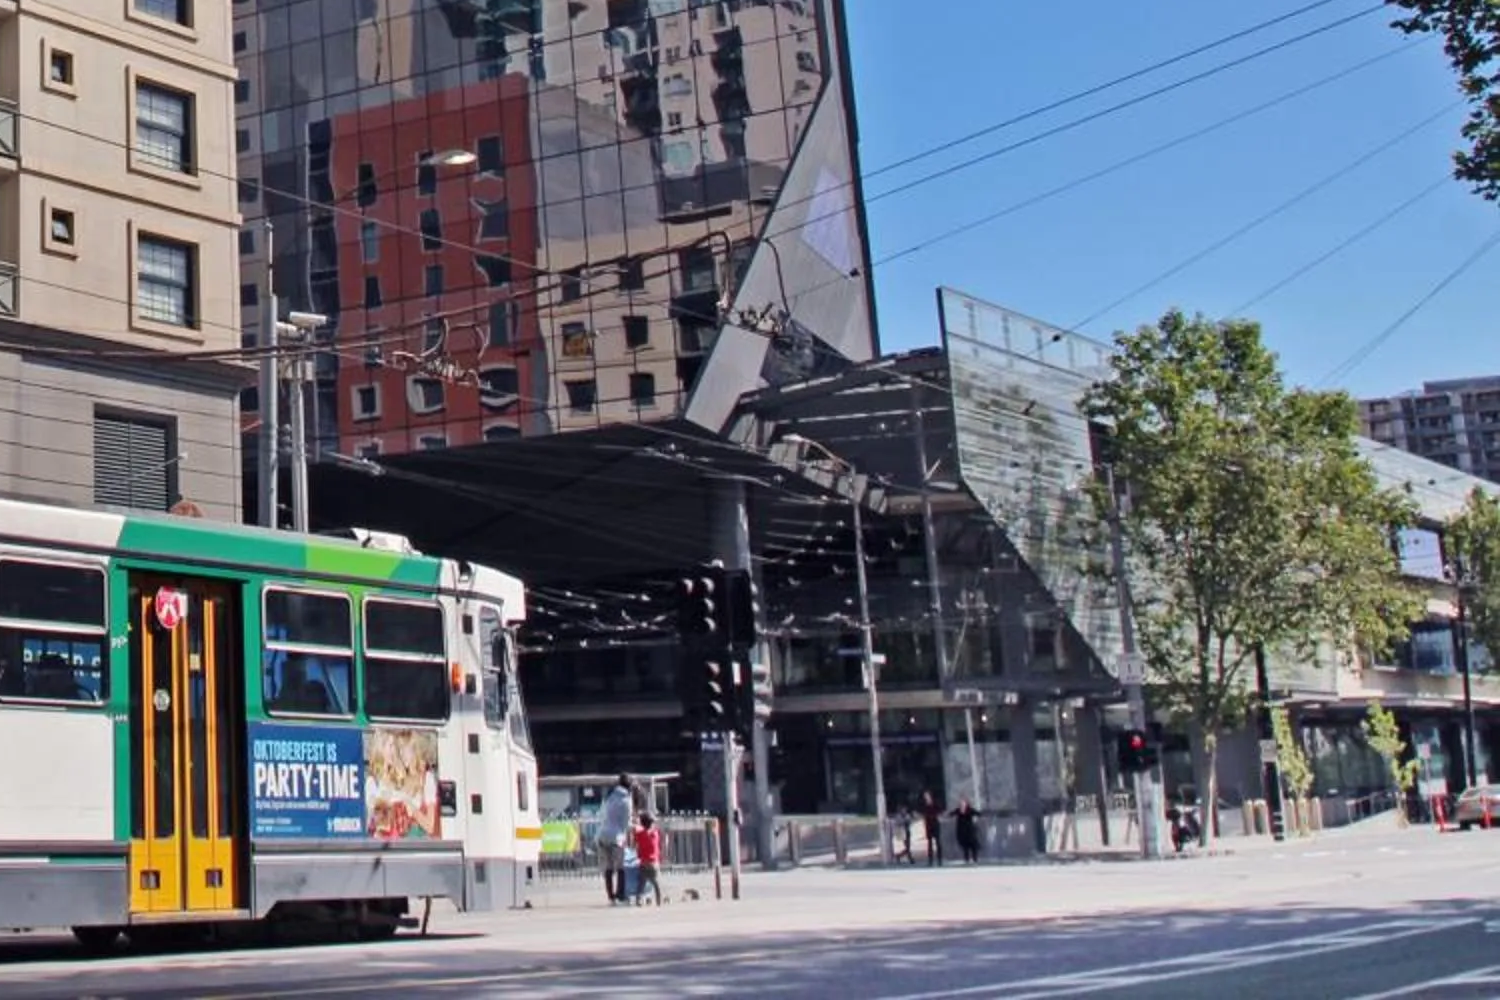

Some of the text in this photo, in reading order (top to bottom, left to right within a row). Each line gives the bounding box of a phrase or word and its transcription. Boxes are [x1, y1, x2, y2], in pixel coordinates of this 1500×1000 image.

[254, 739, 337, 762] OKTOBERFEST IS
[254, 762, 360, 799] PARTY-TIME
